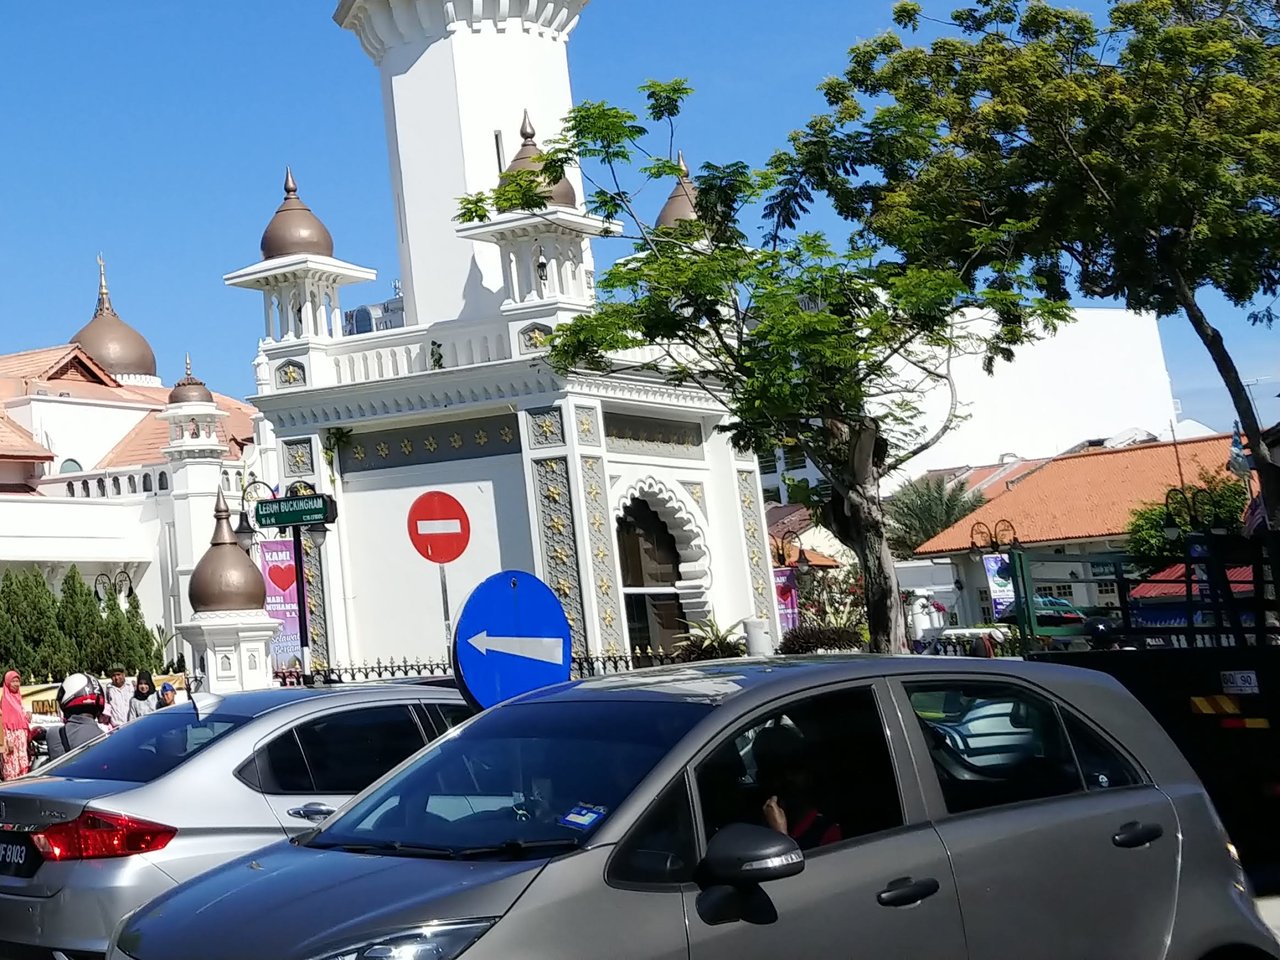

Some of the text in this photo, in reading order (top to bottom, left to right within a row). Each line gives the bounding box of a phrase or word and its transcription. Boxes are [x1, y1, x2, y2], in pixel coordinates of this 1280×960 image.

[258, 497, 323, 515] LEBUH BUCKINGHAM
[265, 551, 291, 562] KAMI
[266, 596, 284, 604] NABI
[275, 645, 301, 655] Bersam
[5, 844, 26, 864] 8103
